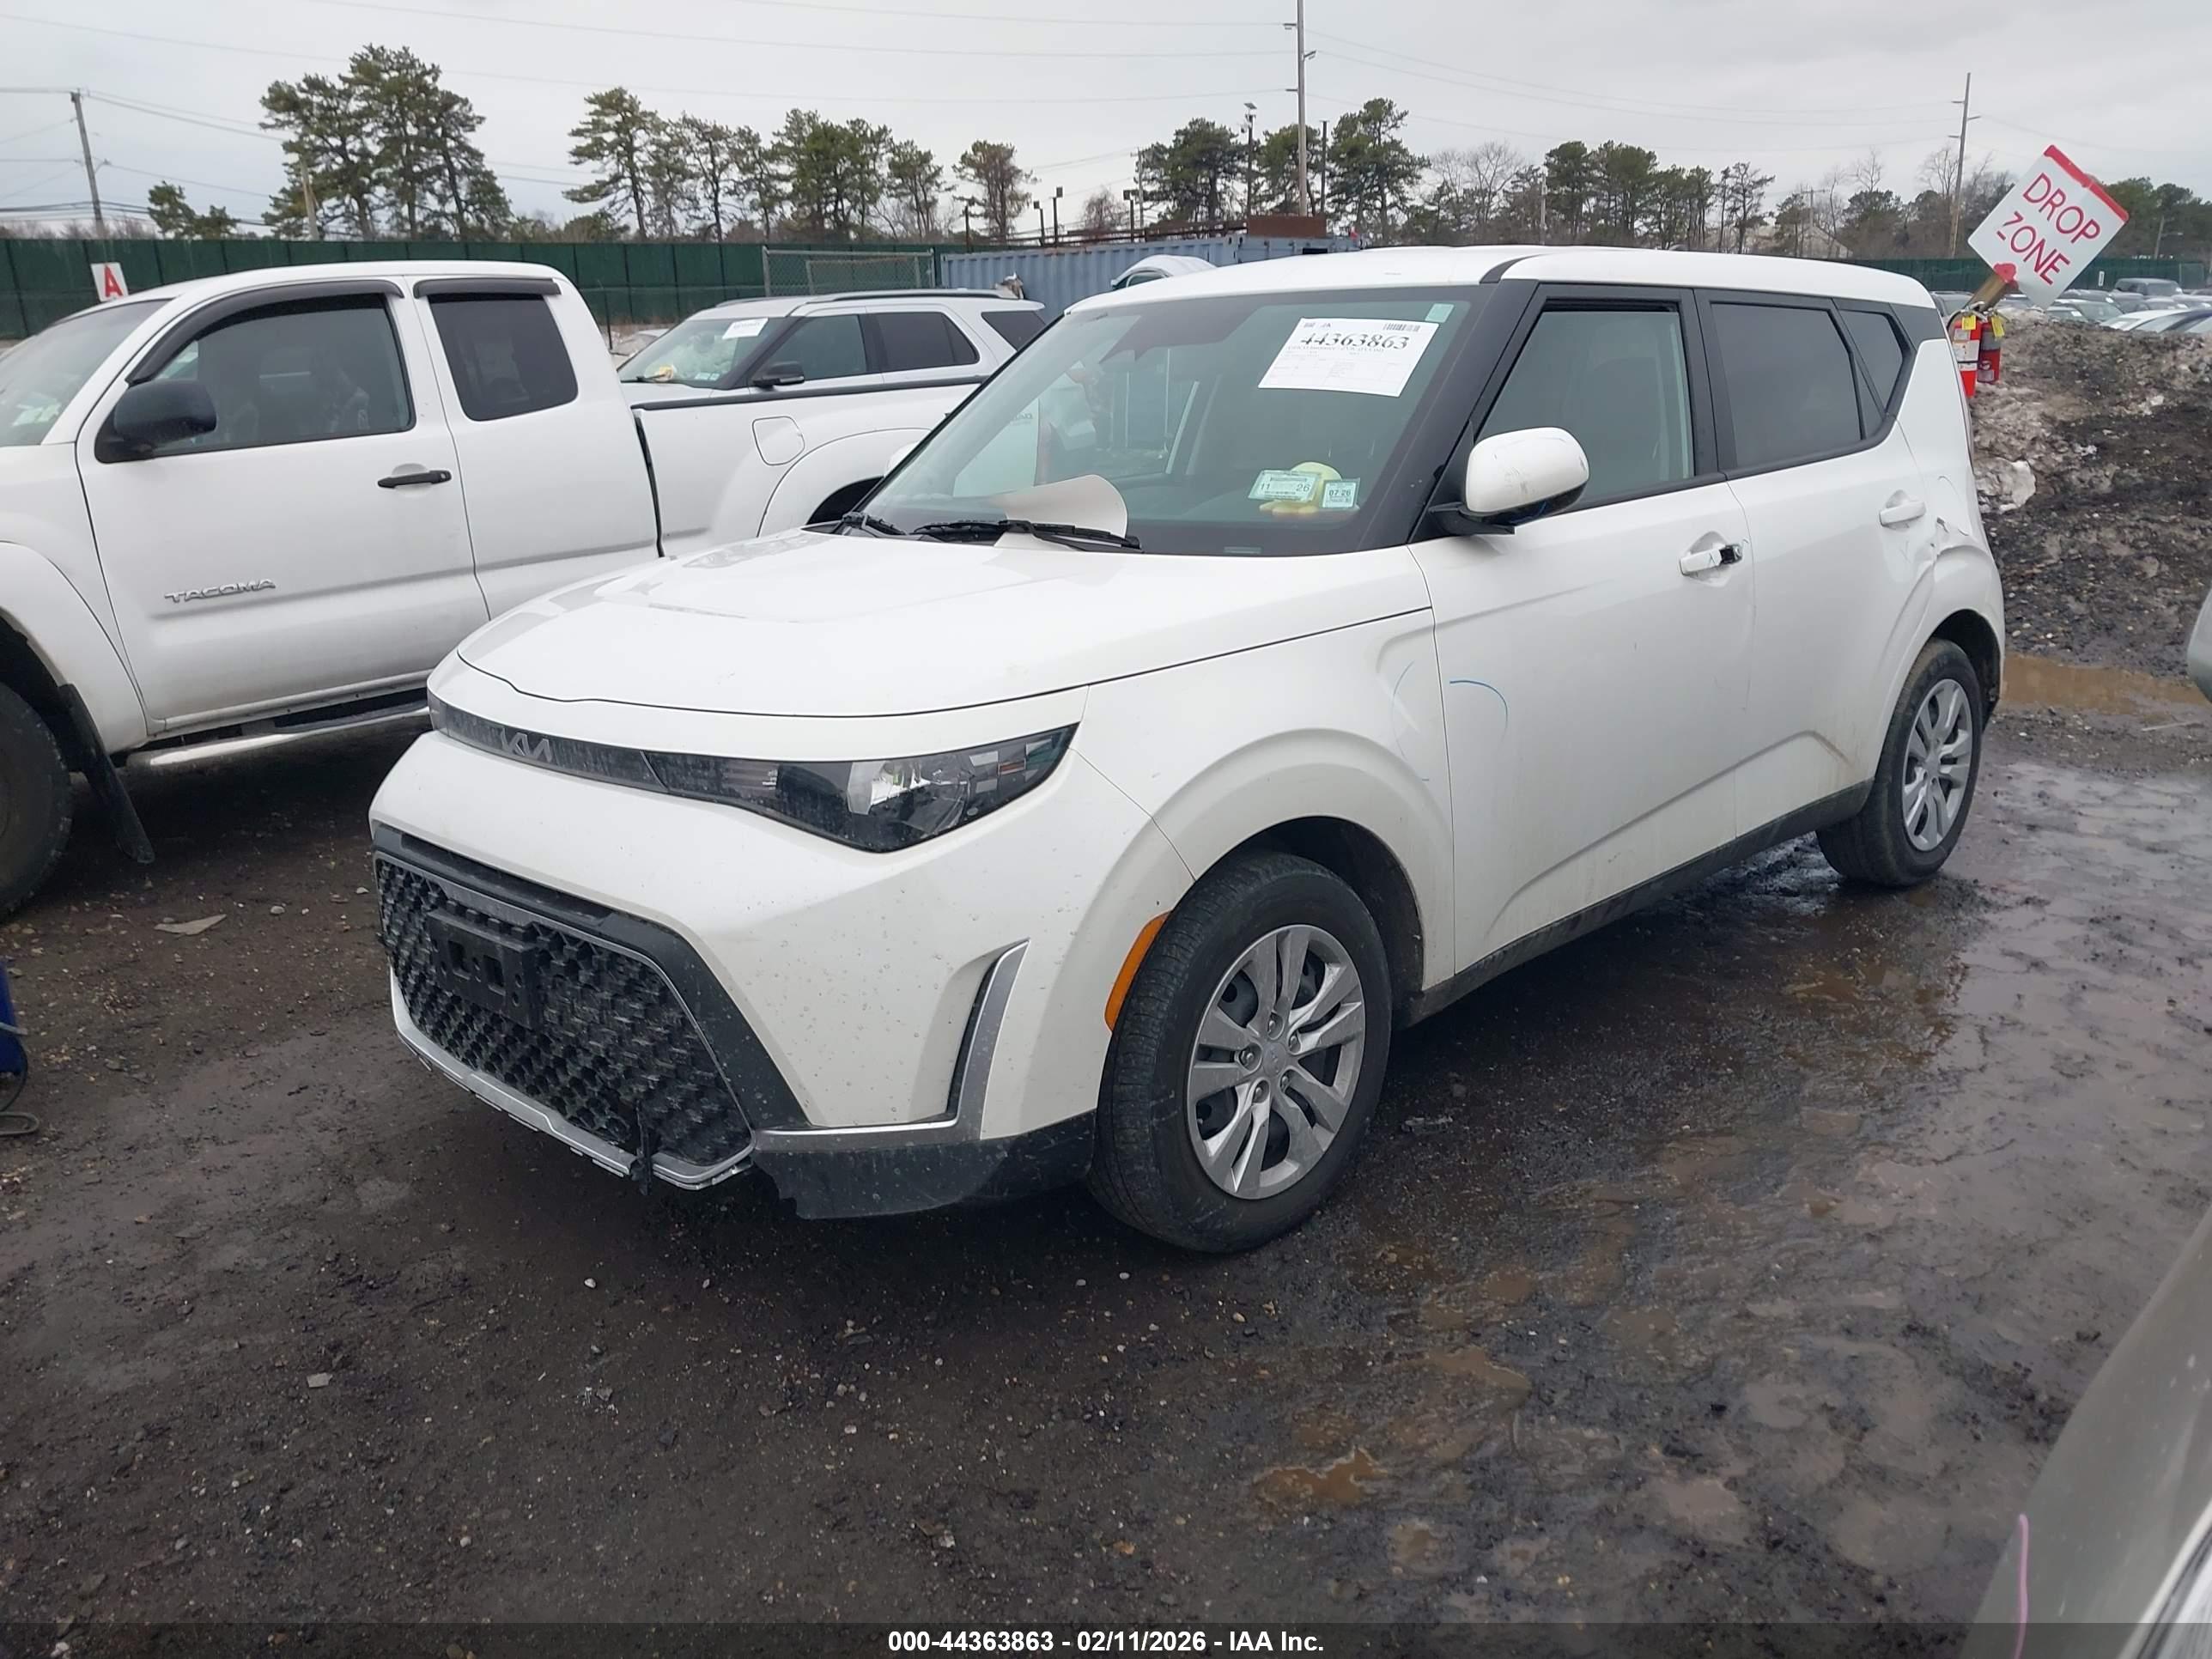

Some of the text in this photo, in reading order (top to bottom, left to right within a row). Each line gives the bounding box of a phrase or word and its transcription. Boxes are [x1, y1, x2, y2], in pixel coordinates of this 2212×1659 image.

[2022, 172, 2101, 244] DROP
[1996, 211, 2070, 285] ZONE
[104, 265, 124, 298] A
[1301, 332, 1410, 349] 44363863
[1296, 483, 1310, 493] 26
[164, 579, 276, 603] TACOMA
